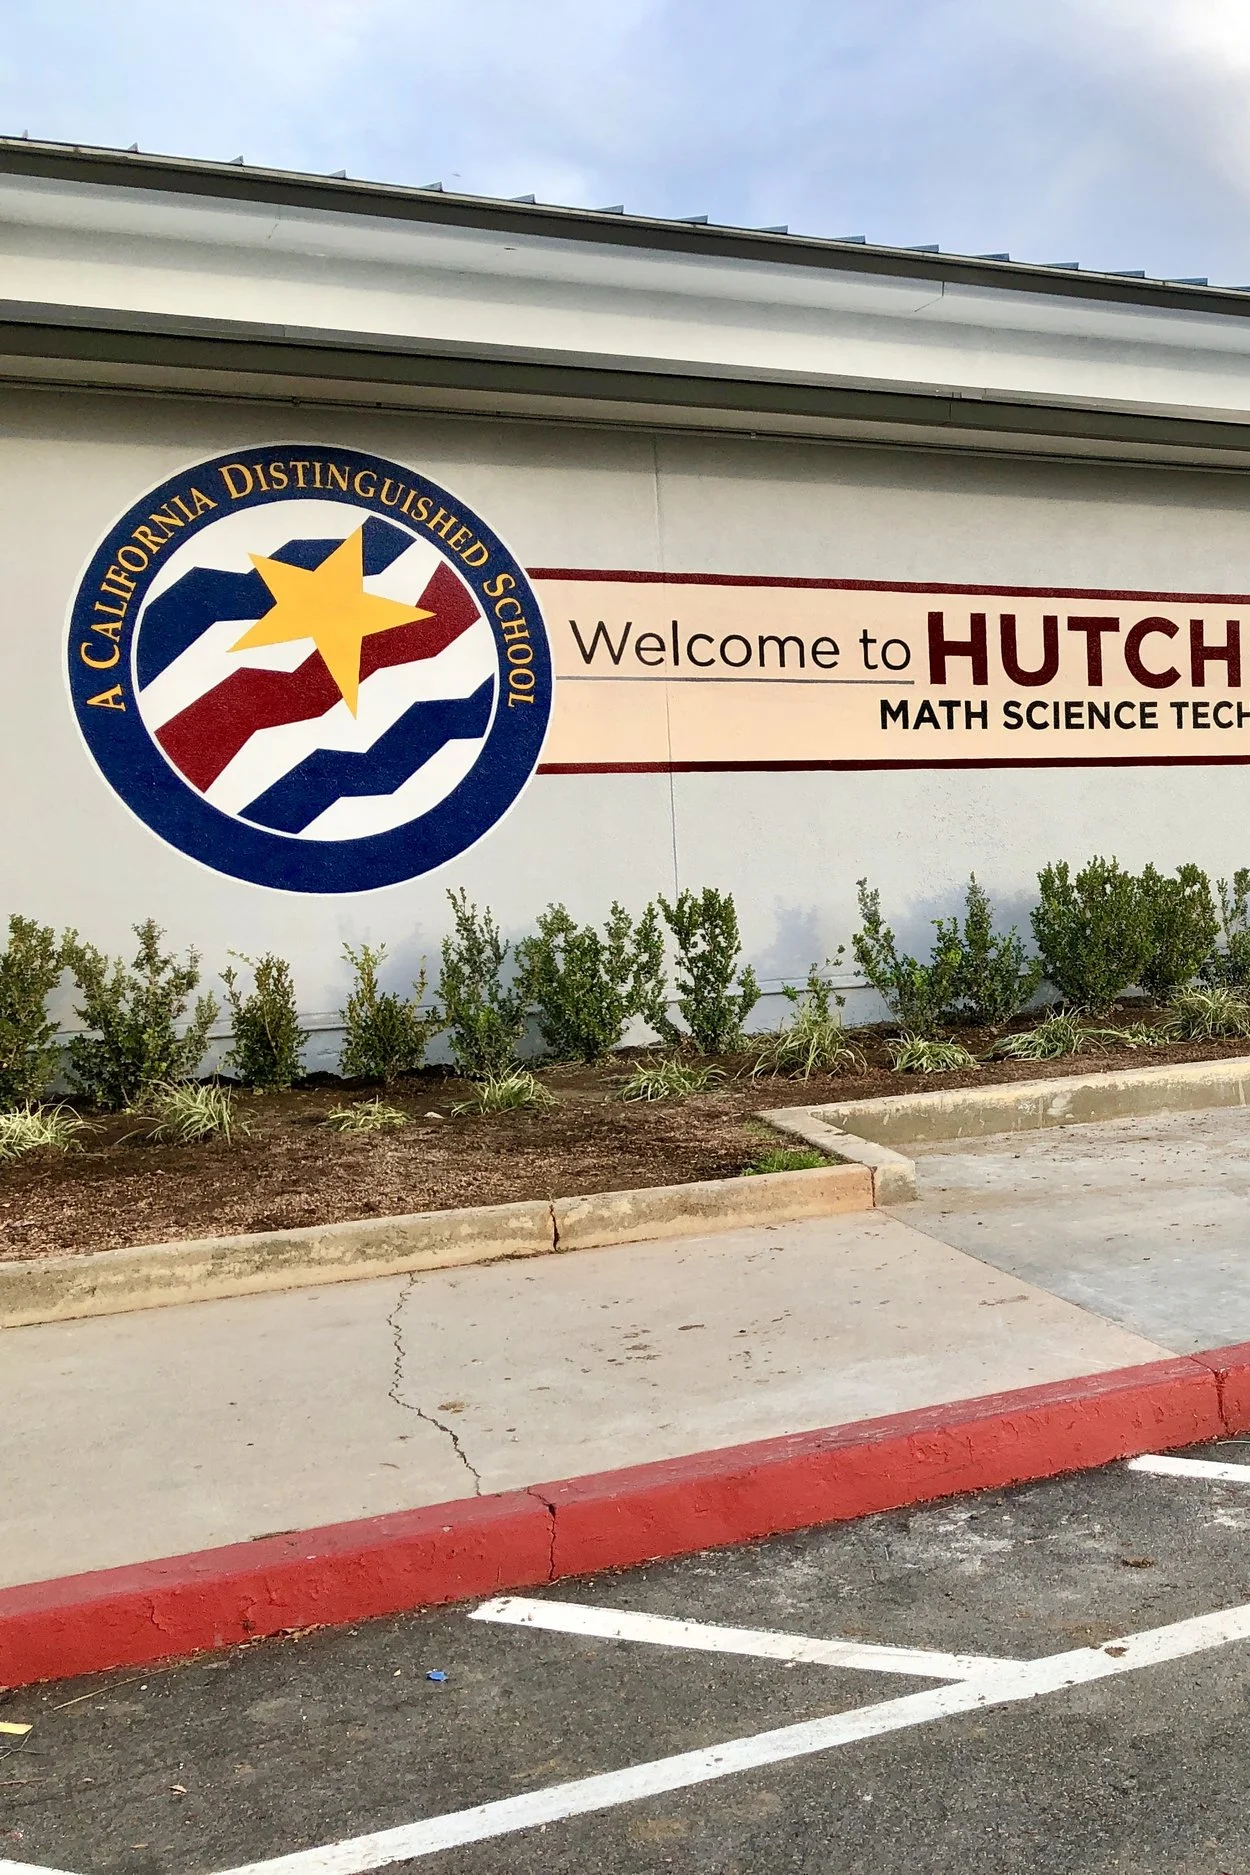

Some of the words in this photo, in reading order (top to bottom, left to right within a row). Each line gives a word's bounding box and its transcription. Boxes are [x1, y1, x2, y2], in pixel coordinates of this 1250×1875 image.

[218, 461, 489, 570] DISTINGUISHED
[80, 487, 217, 669] CALIFORNIA
[483, 573, 535, 708] SCHOOL
[569, 619, 840, 669] Welcome
[859, 629, 911, 671] to
[87, 684, 127, 712] A
[880, 699, 988, 730] MATH
[1003, 699, 1159, 730] SCIENCE
